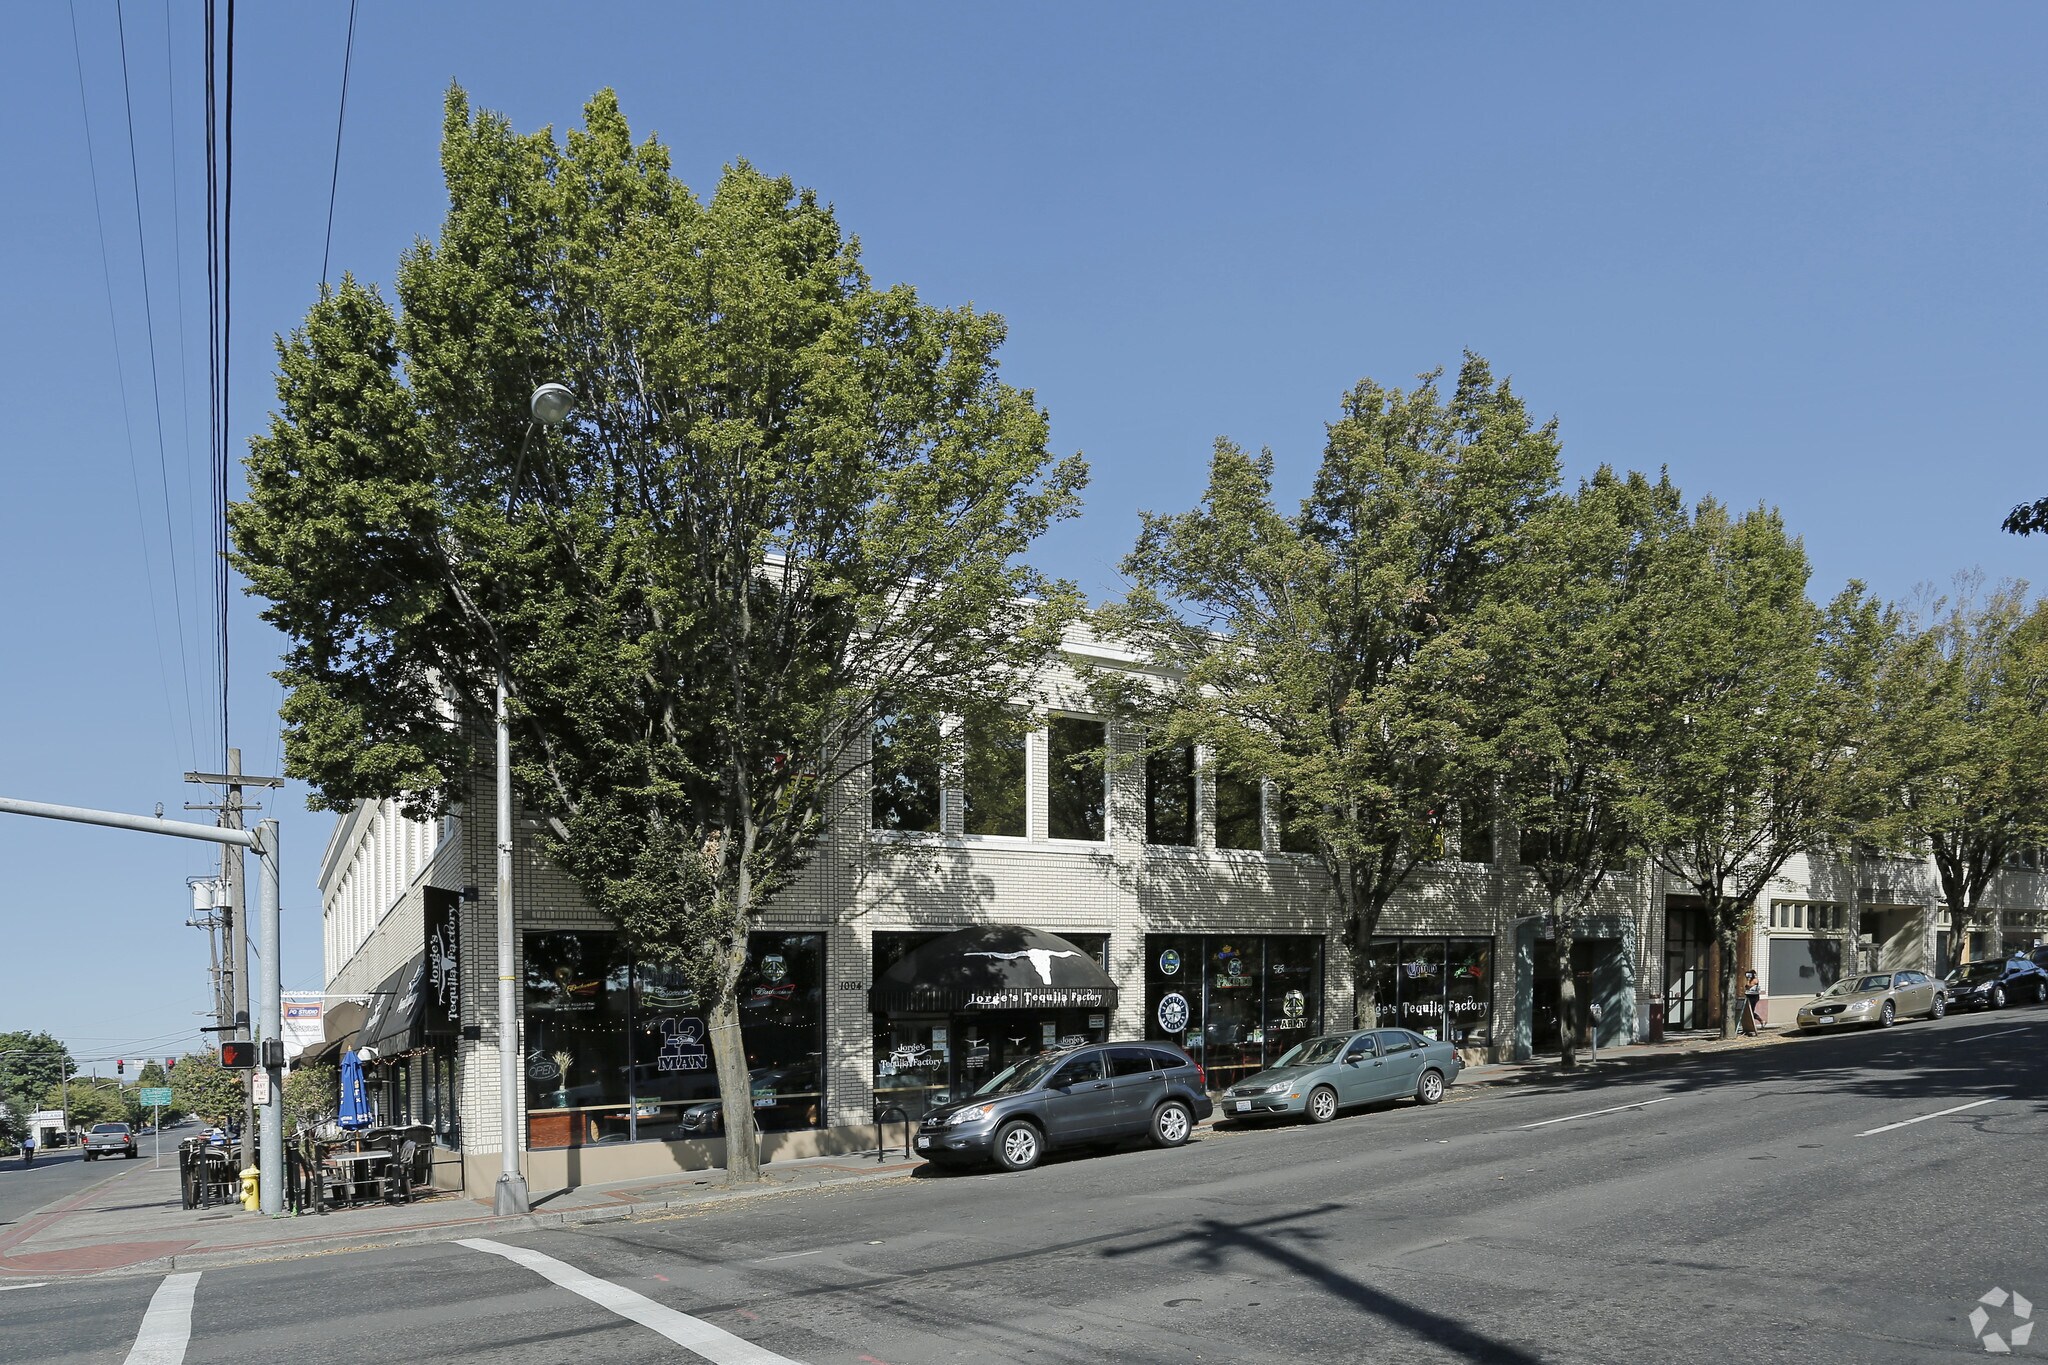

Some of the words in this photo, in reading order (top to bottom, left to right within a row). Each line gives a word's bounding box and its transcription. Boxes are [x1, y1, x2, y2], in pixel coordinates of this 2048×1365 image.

[443, 904, 461, 960] Factory
[430, 934, 440, 988] Jorge's
[447, 967, 459, 1021] Tequila
[840, 981, 863, 991] 1004
[965, 992, 1019, 1007] Jorge's
[1023, 991, 1069, 1006] Tequila
[1071, 989, 1104, 1007] Factory
[1402, 1001, 1446, 1019] Tequila
[1448, 995, 1490, 1018] Factory
[1280, 1018, 1308, 1029] ARMY
[660, 1017, 705, 1057] 12
[1060, 1035, 1086, 1046] Jorge's
[897, 1043, 926, 1054] Jorge's
[528, 1064, 557, 1078] OPEN
[657, 1054, 708, 1072] MAN
[913, 1055, 943, 1071] Factory
